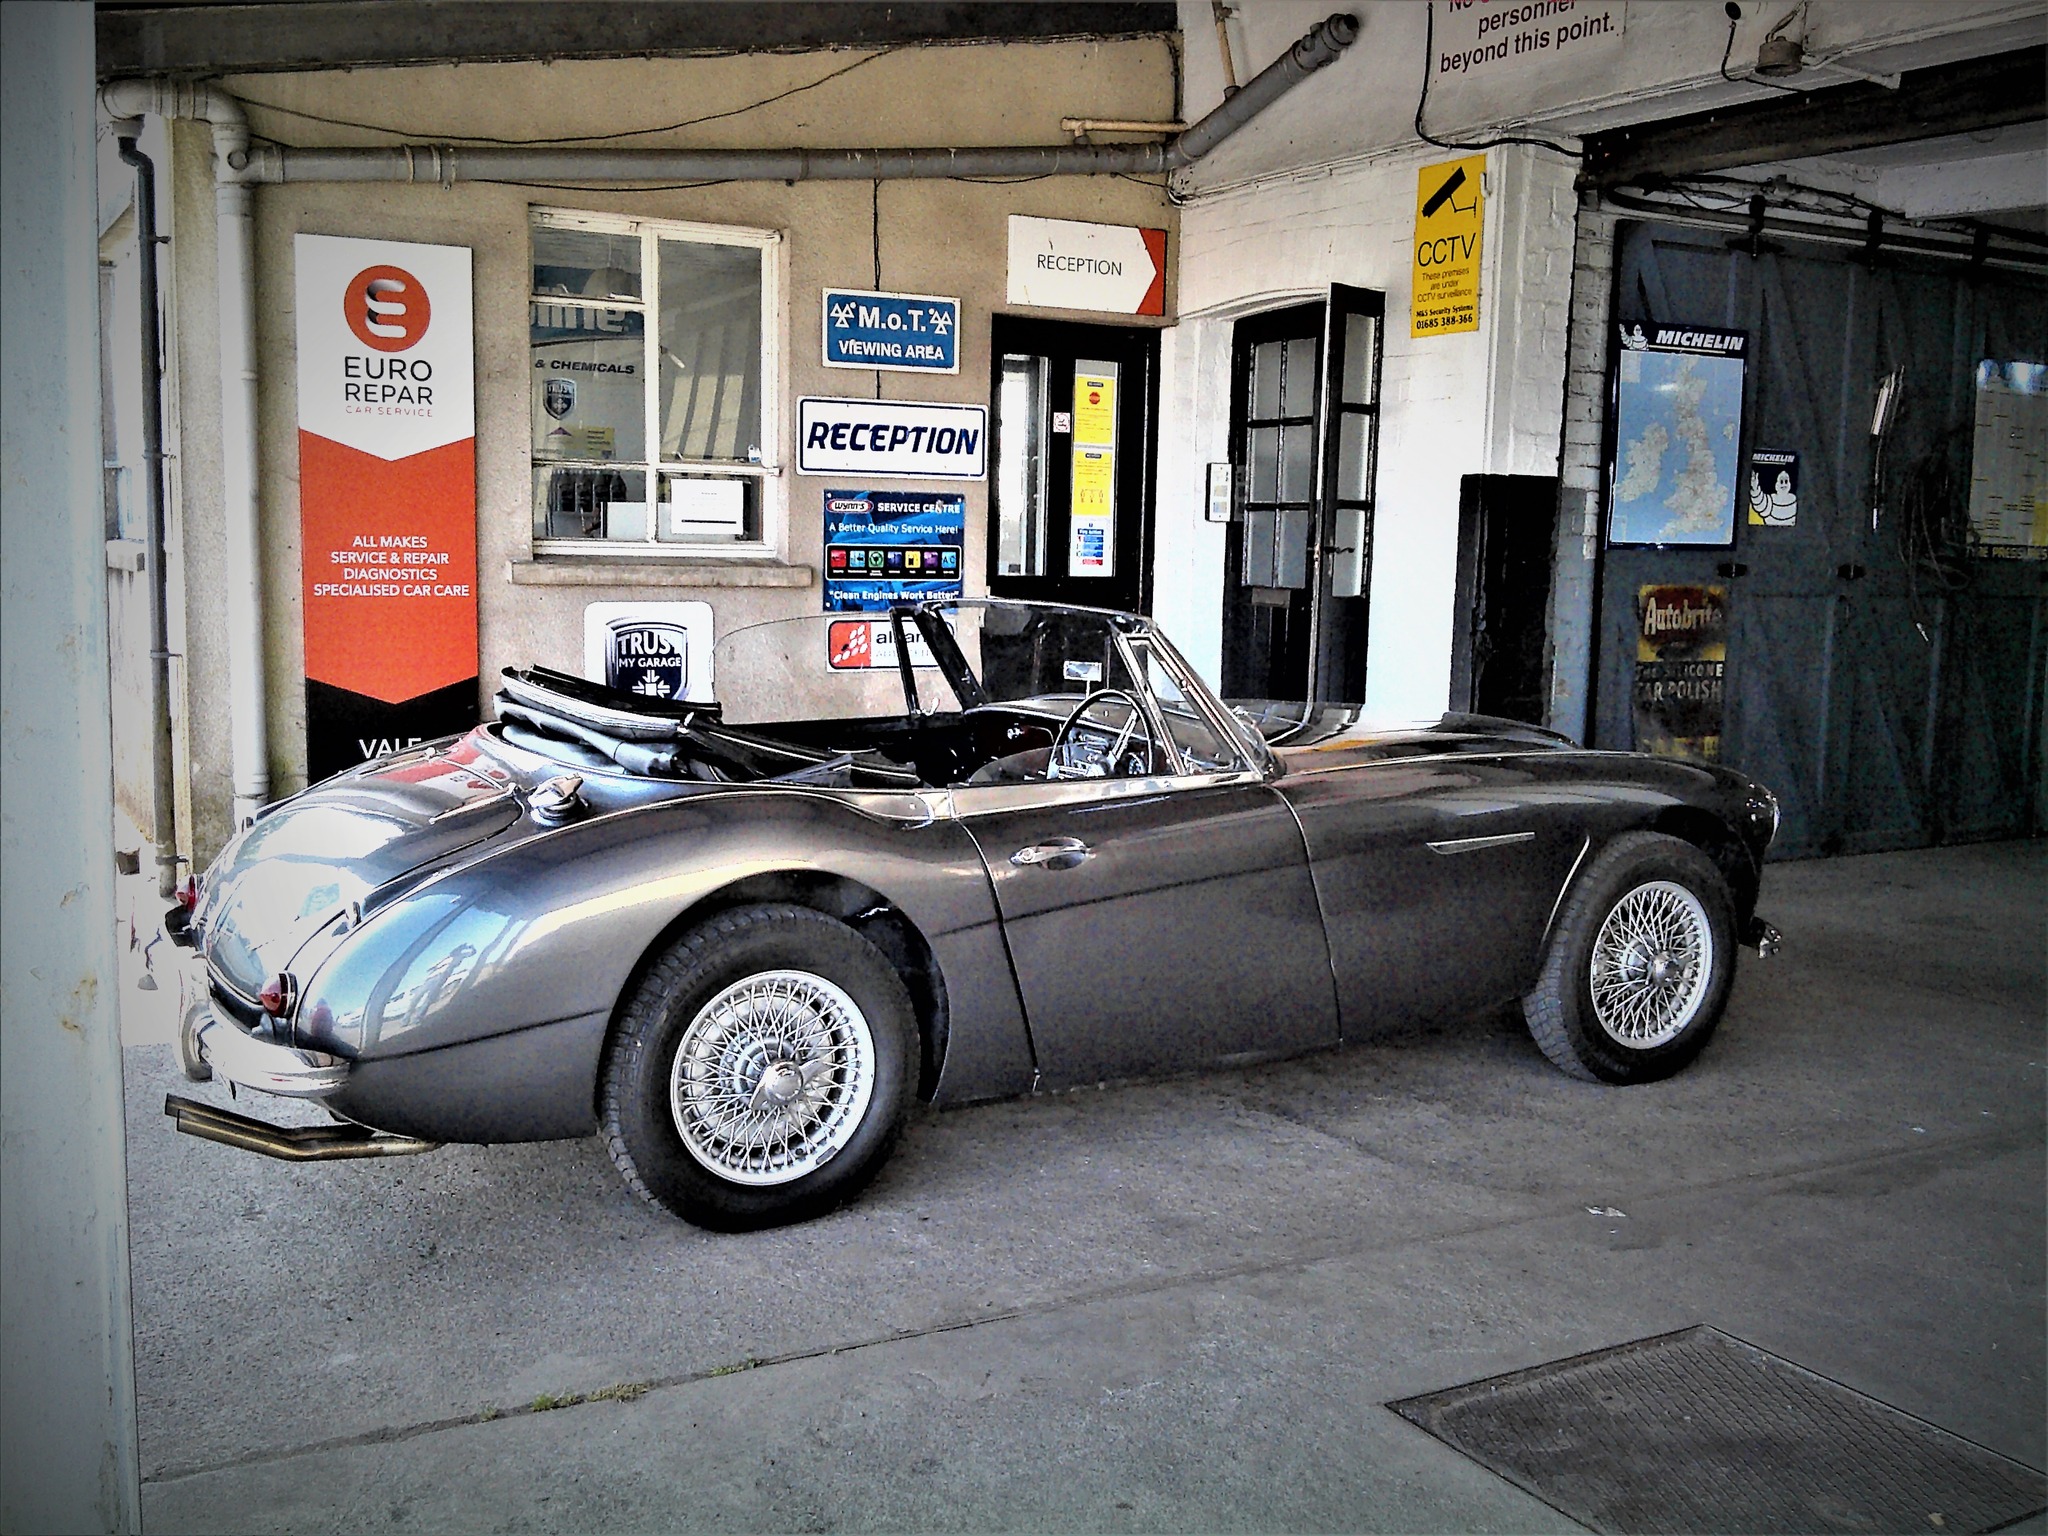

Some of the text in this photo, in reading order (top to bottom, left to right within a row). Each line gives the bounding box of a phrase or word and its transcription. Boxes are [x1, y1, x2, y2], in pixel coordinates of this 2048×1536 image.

[1440, 12, 1615, 73] beyond this point.
[1418, 233, 1476, 267] CCTV
[1037, 254, 1122, 276] RECEPTION
[1422, 267, 1469, 280] These premises
[1442, 280, 1459, 288] under
[1418, 288, 1472, 302] CCTV surveillance
[1429, 307, 1450, 316] Security
[1452, 305, 1474, 314] Systems
[858, 305, 927, 333] M.o.T.
[1416, 314, 1473, 330] 01685 388-366
[1656, 330, 1744, 351] MICHELIN
[838, 339, 945, 361] VIEWING AREA
[344, 356, 433, 382] EURO
[534, 358, 635, 374] & CHEMICALS
[344, 383, 433, 406] REPAR
[345, 406, 433, 418] CAR SERVICE
[806, 421, 980, 456] RECEPTION
[1752, 452, 1795, 463] MICHELIN
[877, 502, 920, 512] SERVICE
[922, 503, 960, 514] CENTRE
[828, 522, 958, 534] A Better Quality Service Here!
[352, 536, 428, 549] ALL MAKES
[331, 552, 450, 565] SERVICE & REPAIR
[344, 568, 438, 581] DIAGNOSTICS
[314, 584, 470, 597] SPECIALISED CAR CARE
[862, 590, 898, 601] Engines
[900, 590, 924, 600] Work
[618, 656, 682, 668] MY GARAGE
